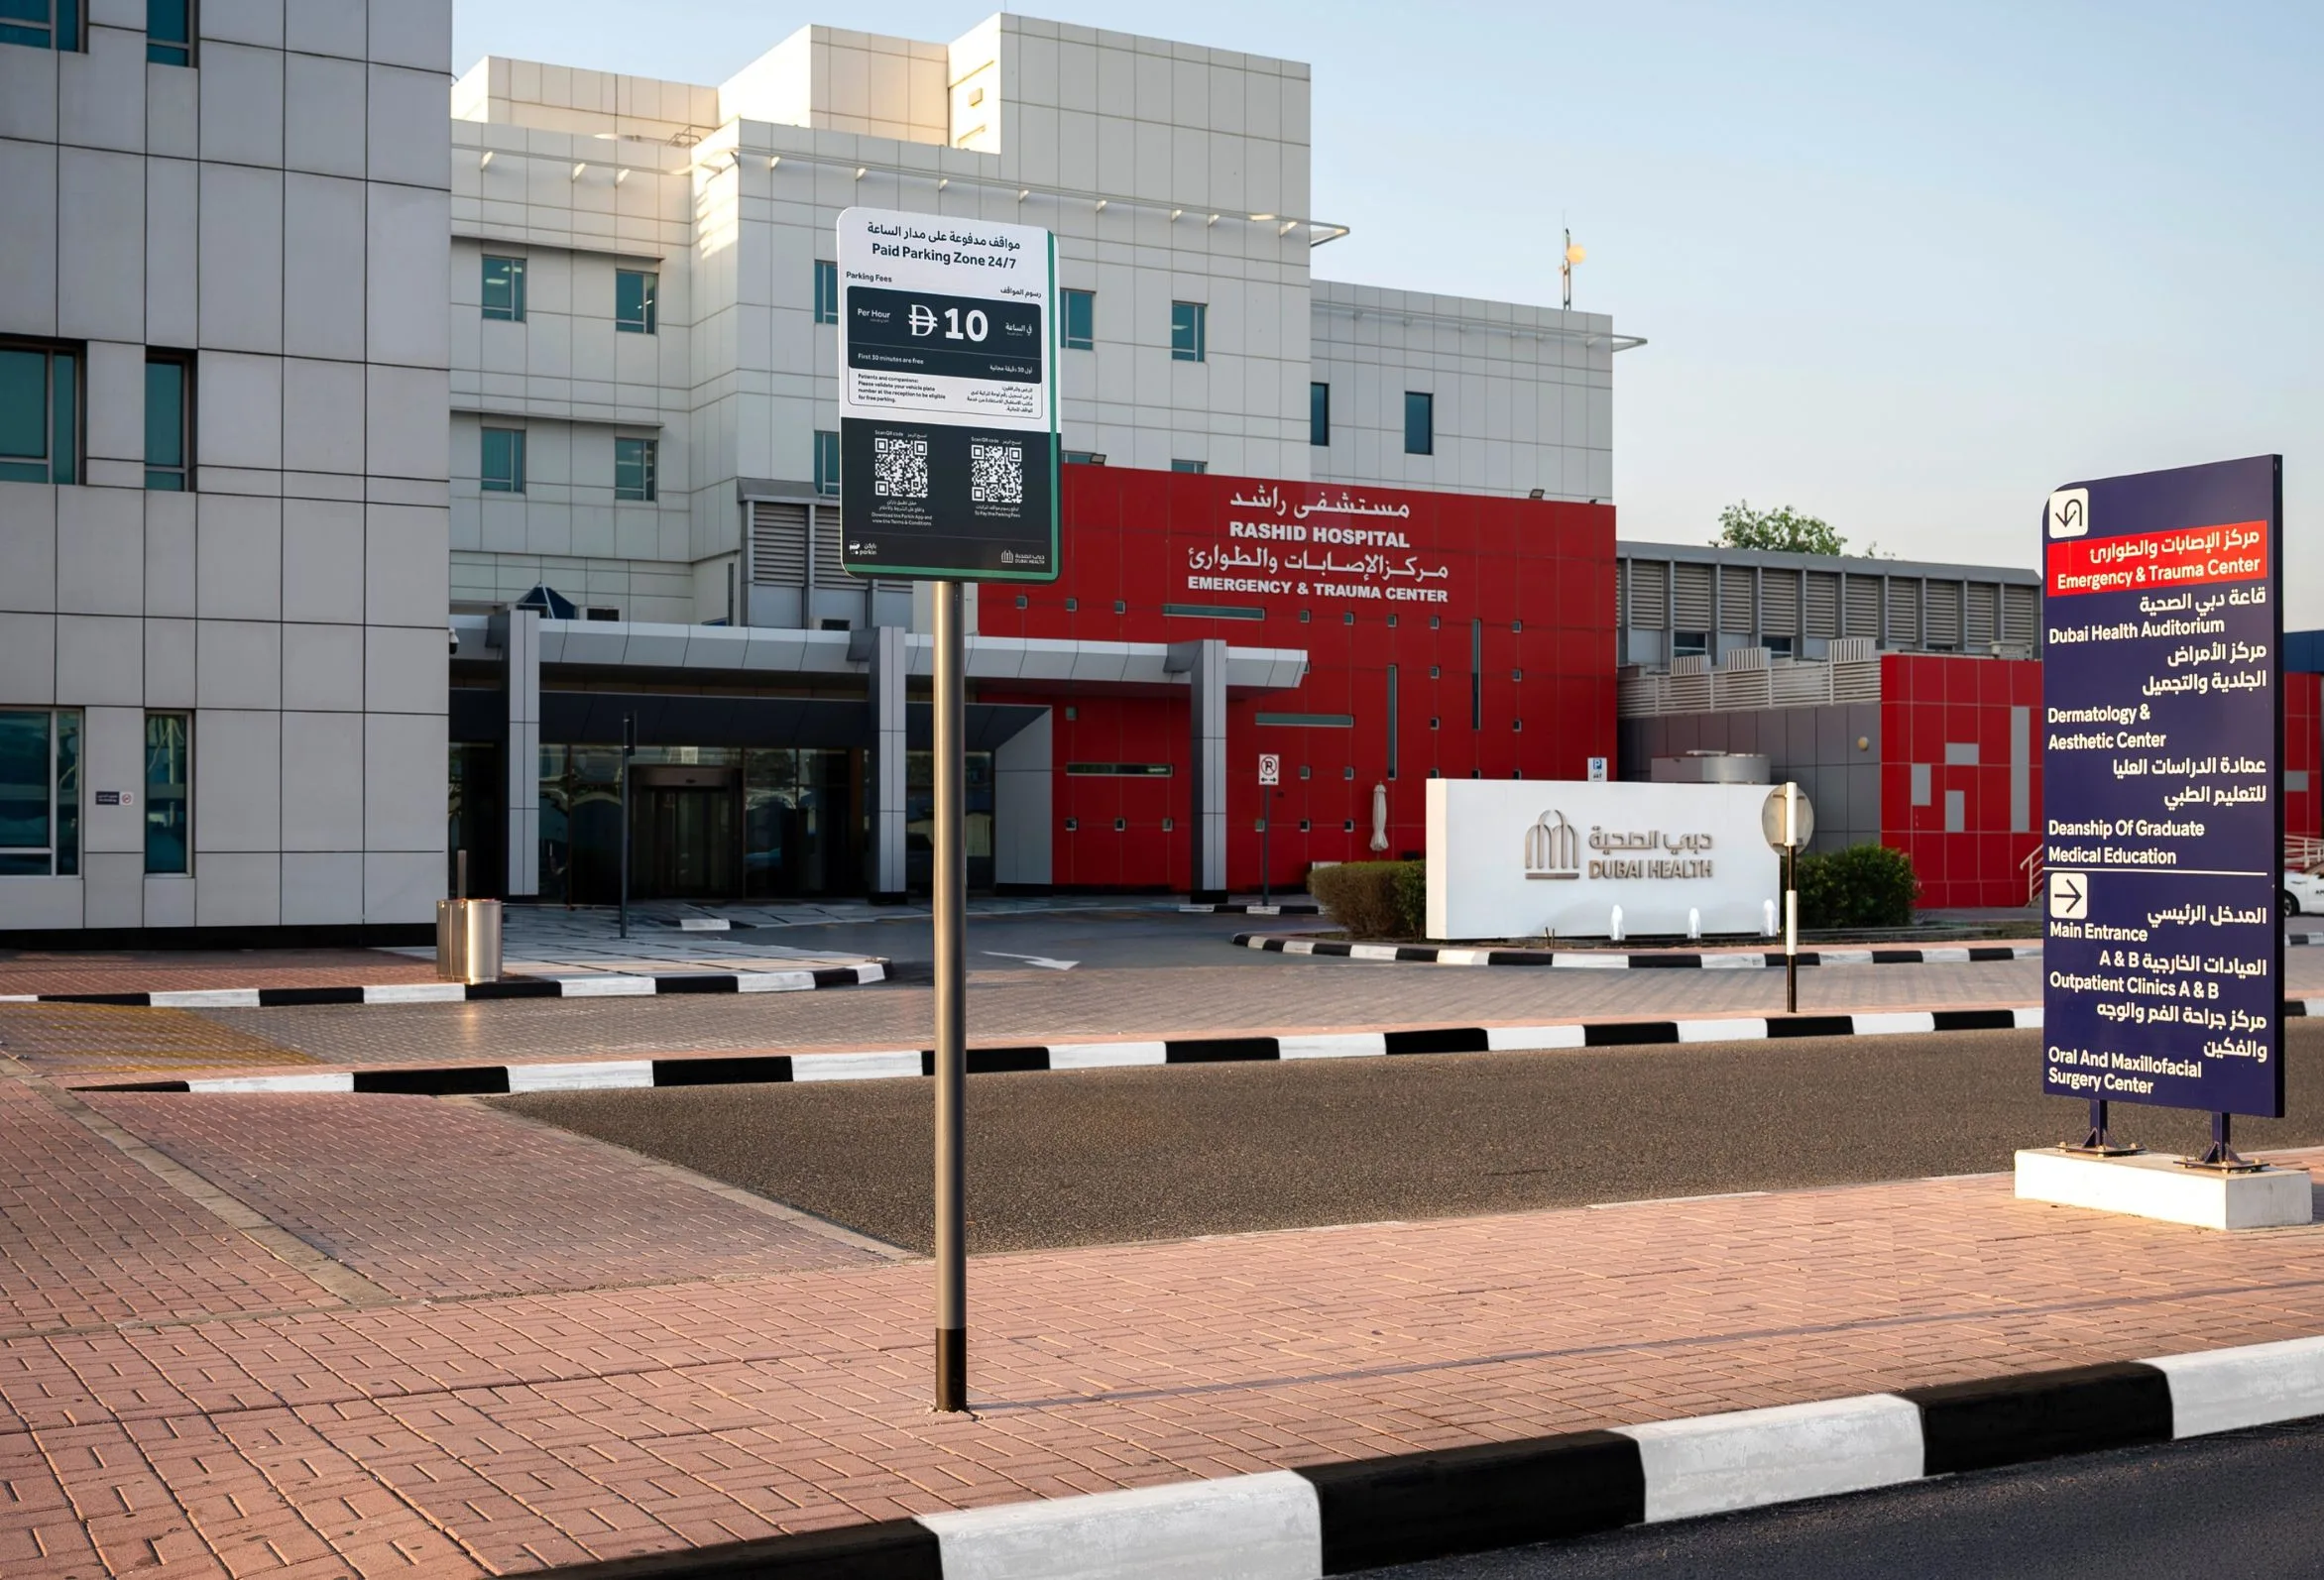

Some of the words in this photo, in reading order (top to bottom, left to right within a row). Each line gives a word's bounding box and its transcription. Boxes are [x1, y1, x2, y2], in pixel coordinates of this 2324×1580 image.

[868, 221, 901, 237] الساعة
[904, 227, 926, 240] مدار
[928, 230, 947, 243] على
[949, 230, 987, 247] مدفوعة
[988, 235, 1020, 251] مواقف
[872, 243, 899, 257] Paid
[902, 246, 951, 265] Parking
[953, 251, 986, 266] Zone
[988, 256, 1016, 269] 24/7
[846, 271, 873, 282] Parking
[1000, 285, 1024, 296] المواقف
[857, 307, 871, 316] Per
[872, 309, 890, 318] Hour
[944, 307, 988, 342] 10
[1004, 322, 1025, 332] الساعة
[1026, 323, 1032, 336] في
[858, 352, 871, 361] First
[1229, 484, 1287, 515] راشد
[1294, 491, 1410, 518] مستشفى
[1229, 520, 1307, 541] RASHID
[1313, 526, 1410, 548] HOSPITAL
[2161, 531, 2220, 555] الإصابات
[2224, 528, 2260, 551] مركز
[1188, 544, 1278, 575] والطوارئ
[2090, 539, 2158, 564] والطوارئ
[2057, 569, 2133, 591] Emergency
[2135, 567, 2146, 583] &
[2149, 561, 2204, 581] Trauma
[2207, 557, 2261, 576] Center
[1188, 576, 1292, 595] EMERGENCY
[1297, 582, 1309, 596] &
[1314, 583, 1381, 600] TRAUMA
[1385, 587, 1449, 603] CENTER
[2229, 586, 2266, 607] قاعة
[2140, 593, 2192, 618] الصحية
[2195, 594, 2225, 617] دبي
[2049, 625, 2088, 644] Dubai
[2091, 622, 2138, 642] Health
[2141, 617, 2225, 638] Auditorium
[2167, 641, 2226, 667] الأمراض
[2230, 641, 2267, 665] مركز
[2142, 673, 2208, 697] والتجميل
[2211, 670, 2266, 693] الجلدية
[2047, 705, 2137, 725] Dermatology
[2140, 703, 2150, 721] &
[2047, 732, 2114, 749] Aesthetic
[2116, 732, 2167, 748] Center
[2113, 758, 2148, 780] العليا
[2151, 757, 2216, 778] الدراسات
[2220, 756, 2266, 775] عمادة
[2163, 785, 2210, 811] الطبي
[2213, 785, 2266, 807] للتعليم
[1588, 825, 1659, 855] الصحية
[2048, 820, 2113, 840] Deanship
[2115, 820, 2134, 837] Of
[2136, 820, 2205, 837] Graduate
[1663, 833, 1713, 855] دبي
[2048, 846, 2101, 863] Medical
[2104, 846, 2176, 864] Education
[1588, 859, 1644, 880] DUBAI
[1648, 859, 1713, 880] HEALTH
[2148, 903, 2206, 928] الرئيسي
[2210, 906, 2266, 926] المدخل
[2049, 921, 2082, 940] Main
[2084, 923, 2149, 943] Entrance
[2099, 951, 2112, 966] A
[2114, 951, 2125, 967] &
[2129, 952, 2140, 967] B
[2143, 953, 2200, 975] الخارجية
[2204, 955, 2267, 979] العيادات
[2049, 971, 2125, 993] Outpatient
[2127, 976, 2176, 996] Clinics
[2178, 981, 2191, 999] A
[2193, 981, 2205, 999] &
[2208, 982, 2219, 1000] B
[2097, 1001, 2145, 1024] والوجه
[2148, 1005, 2179, 1024] الفم
[2183, 1006, 2227, 1030] جراحة
[2230, 1009, 2267, 1033] مركز
[2203, 1037, 2267, 1064] والفكين
[2048, 1046, 2077, 1065] Oral
[2080, 1049, 2109, 1069] And
[2111, 1053, 2202, 1078] Maxillofacial
[2048, 1067, 2101, 1092] Surgery
[2104, 1073, 2154, 1094] Center
